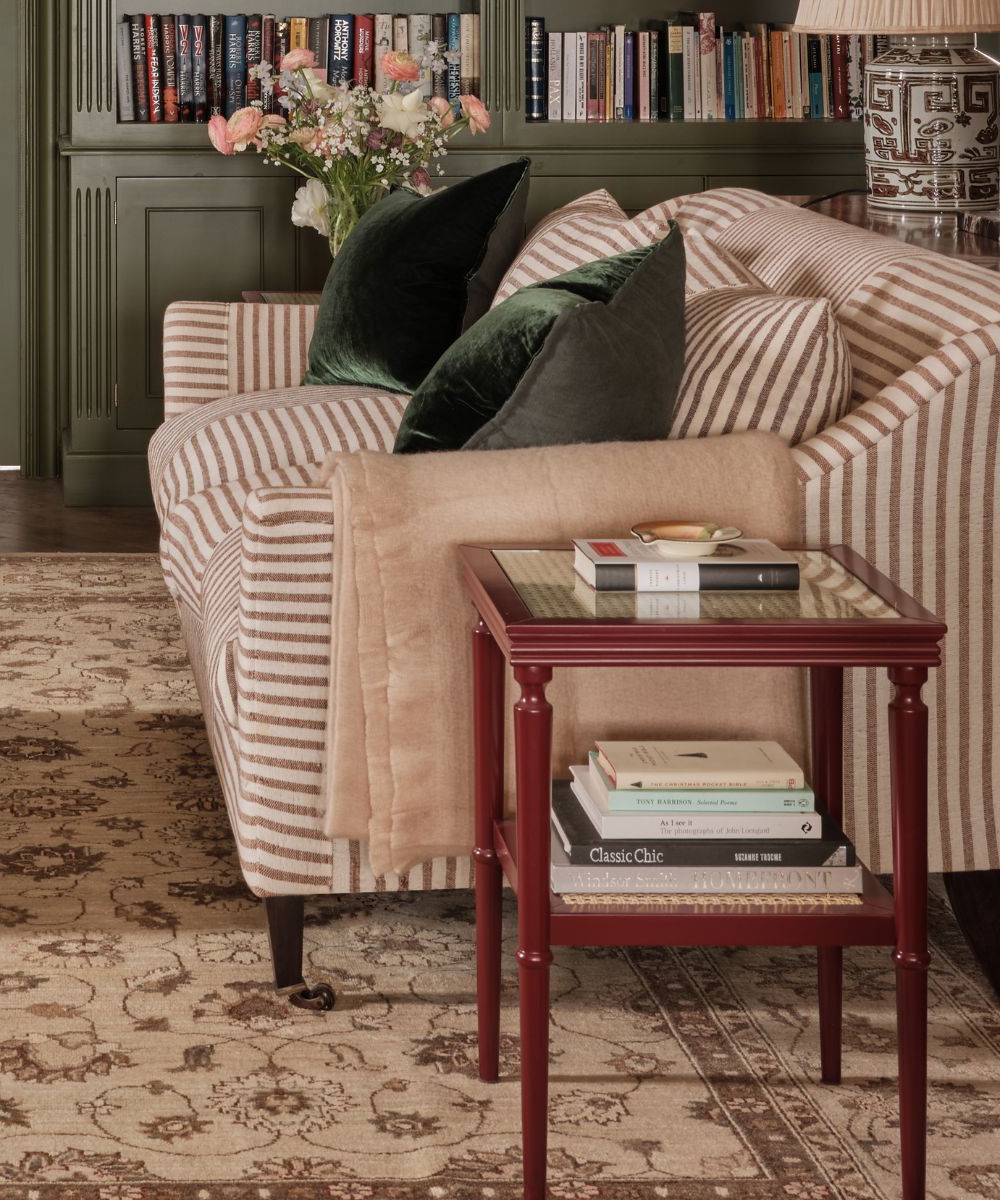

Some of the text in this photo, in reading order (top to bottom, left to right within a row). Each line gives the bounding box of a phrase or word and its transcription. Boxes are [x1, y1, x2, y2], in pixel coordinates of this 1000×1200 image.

[132, 23, 140, 61] HARRIS
[334, 20, 342, 60] HOROWITZ
[166, 55, 175, 88] POMPEII
[450, 63, 460, 99] NEMESIS
[152, 79, 160, 106] INDEX
[550, 80, 561, 104] PAX
[674, 828, 714, 837] photographs
[590, 847, 664, 863] Classic Chic
[734, 853, 758, 862] SUZANNE
[692, 870, 832, 890] HOMEFRONT
